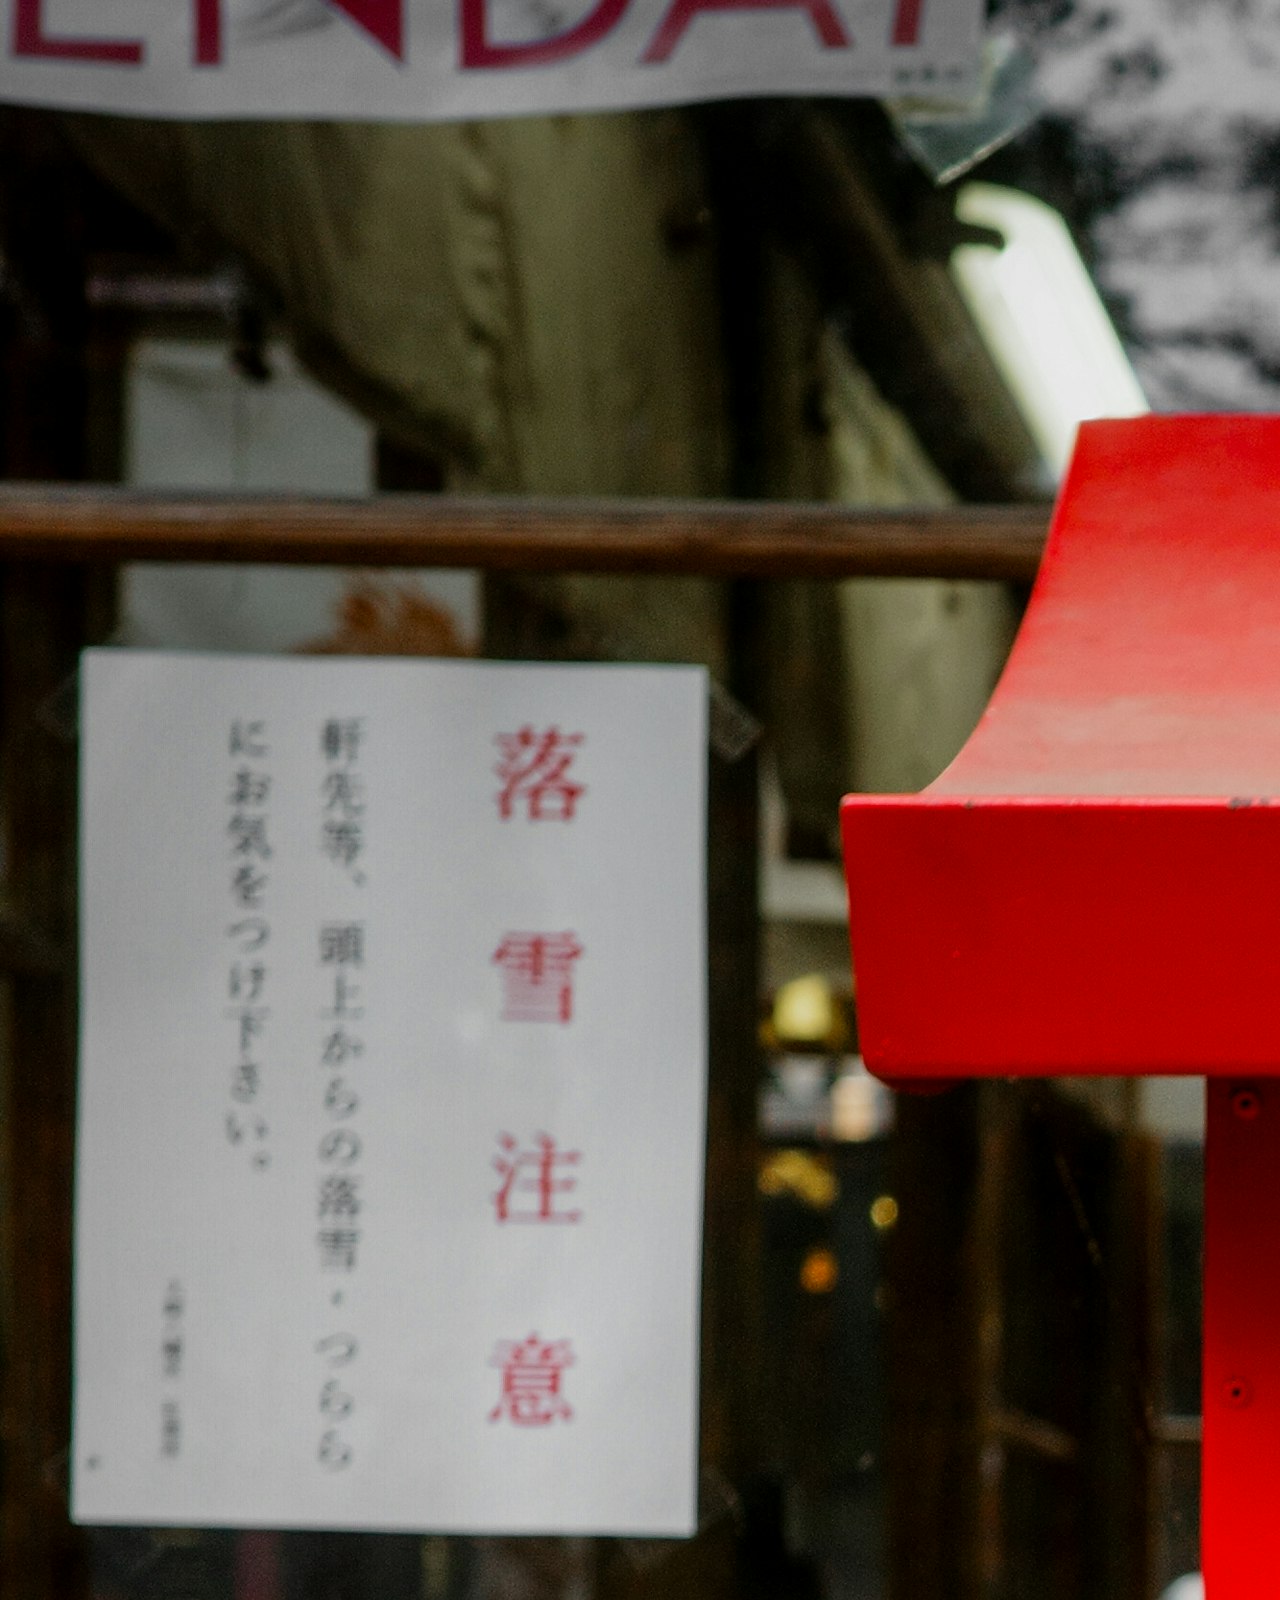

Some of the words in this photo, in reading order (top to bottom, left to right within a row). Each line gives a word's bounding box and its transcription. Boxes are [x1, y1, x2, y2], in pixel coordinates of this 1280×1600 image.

[224, 717, 273, 1173] にお気をつけ下さい。
[492, 726, 586, 1426] 落雪注意
